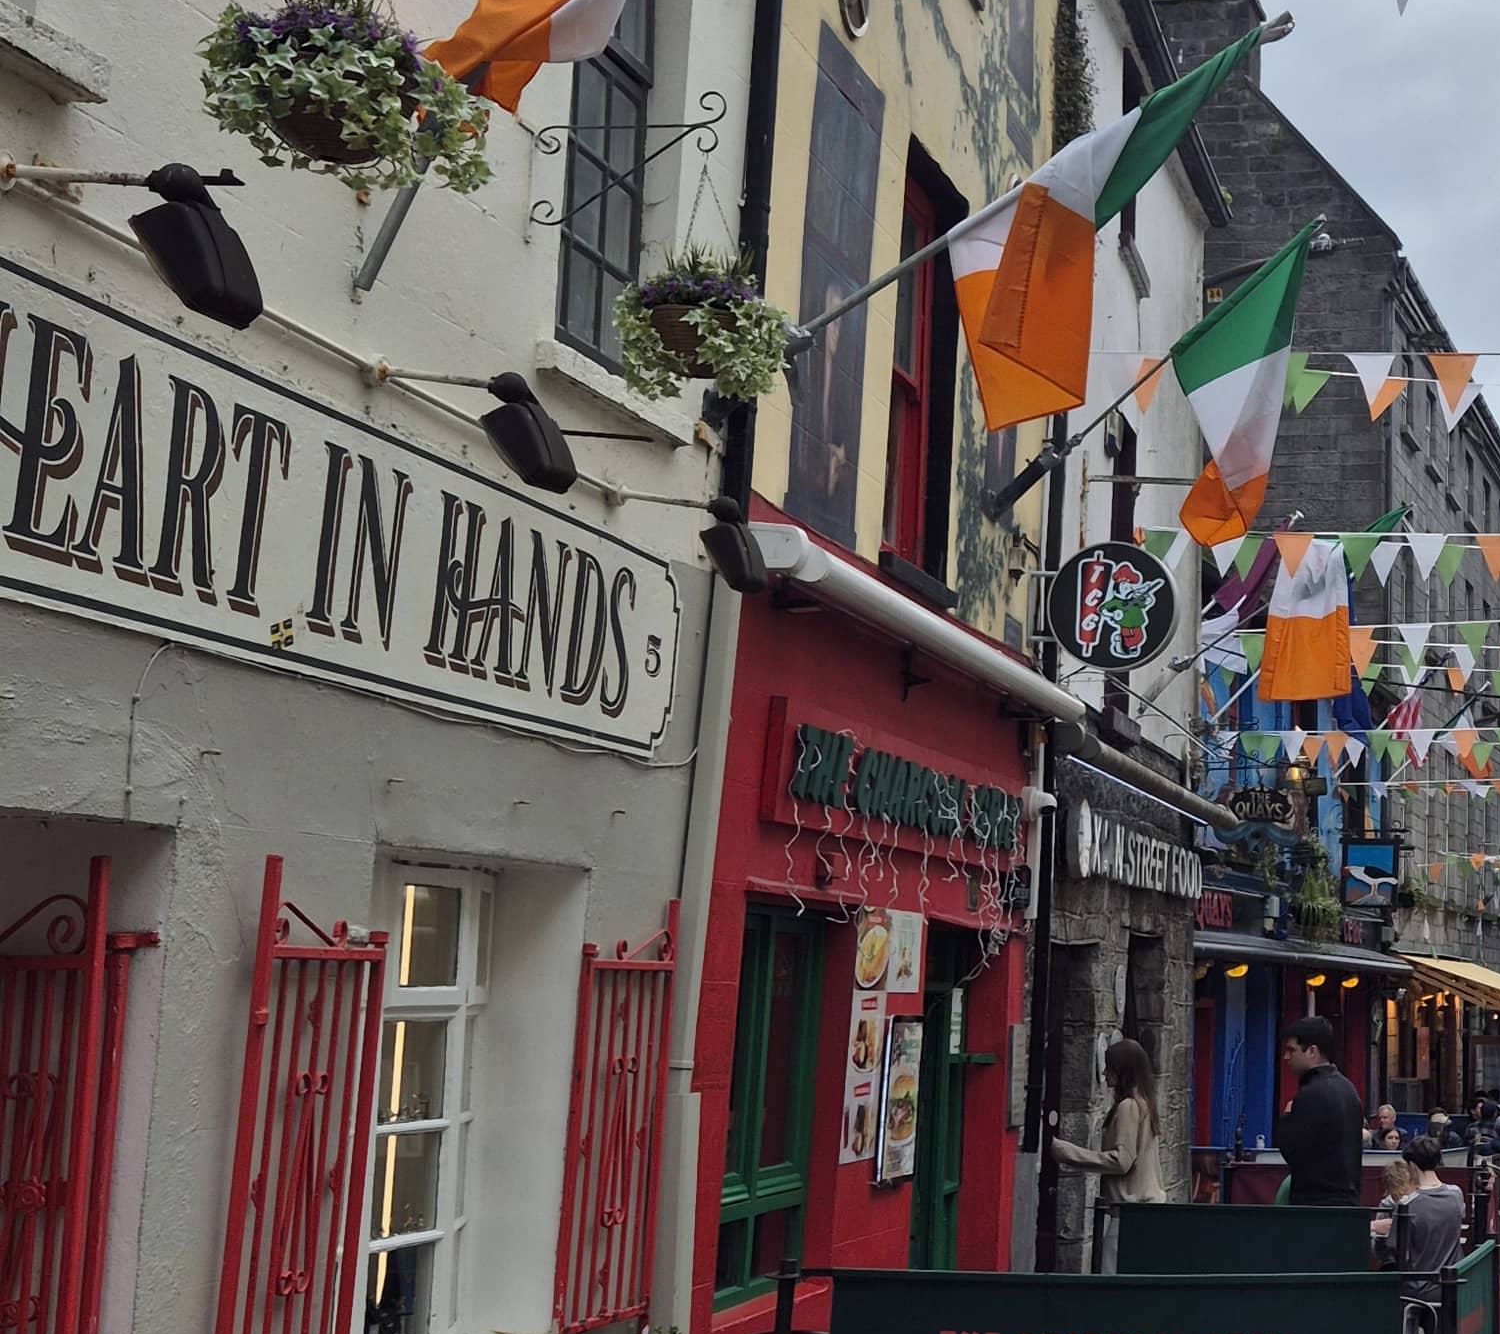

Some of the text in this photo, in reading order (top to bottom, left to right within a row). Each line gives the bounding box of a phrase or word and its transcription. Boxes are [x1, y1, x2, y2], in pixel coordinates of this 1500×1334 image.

[0, 297, 662, 719] EART IN HANDS 5
[1234, 800, 1285, 820] QUAYS
[1249, 791, 1272, 803] THE
[1124, 830, 1171, 893] STREET
[1171, 844, 1203, 900] FOOD
